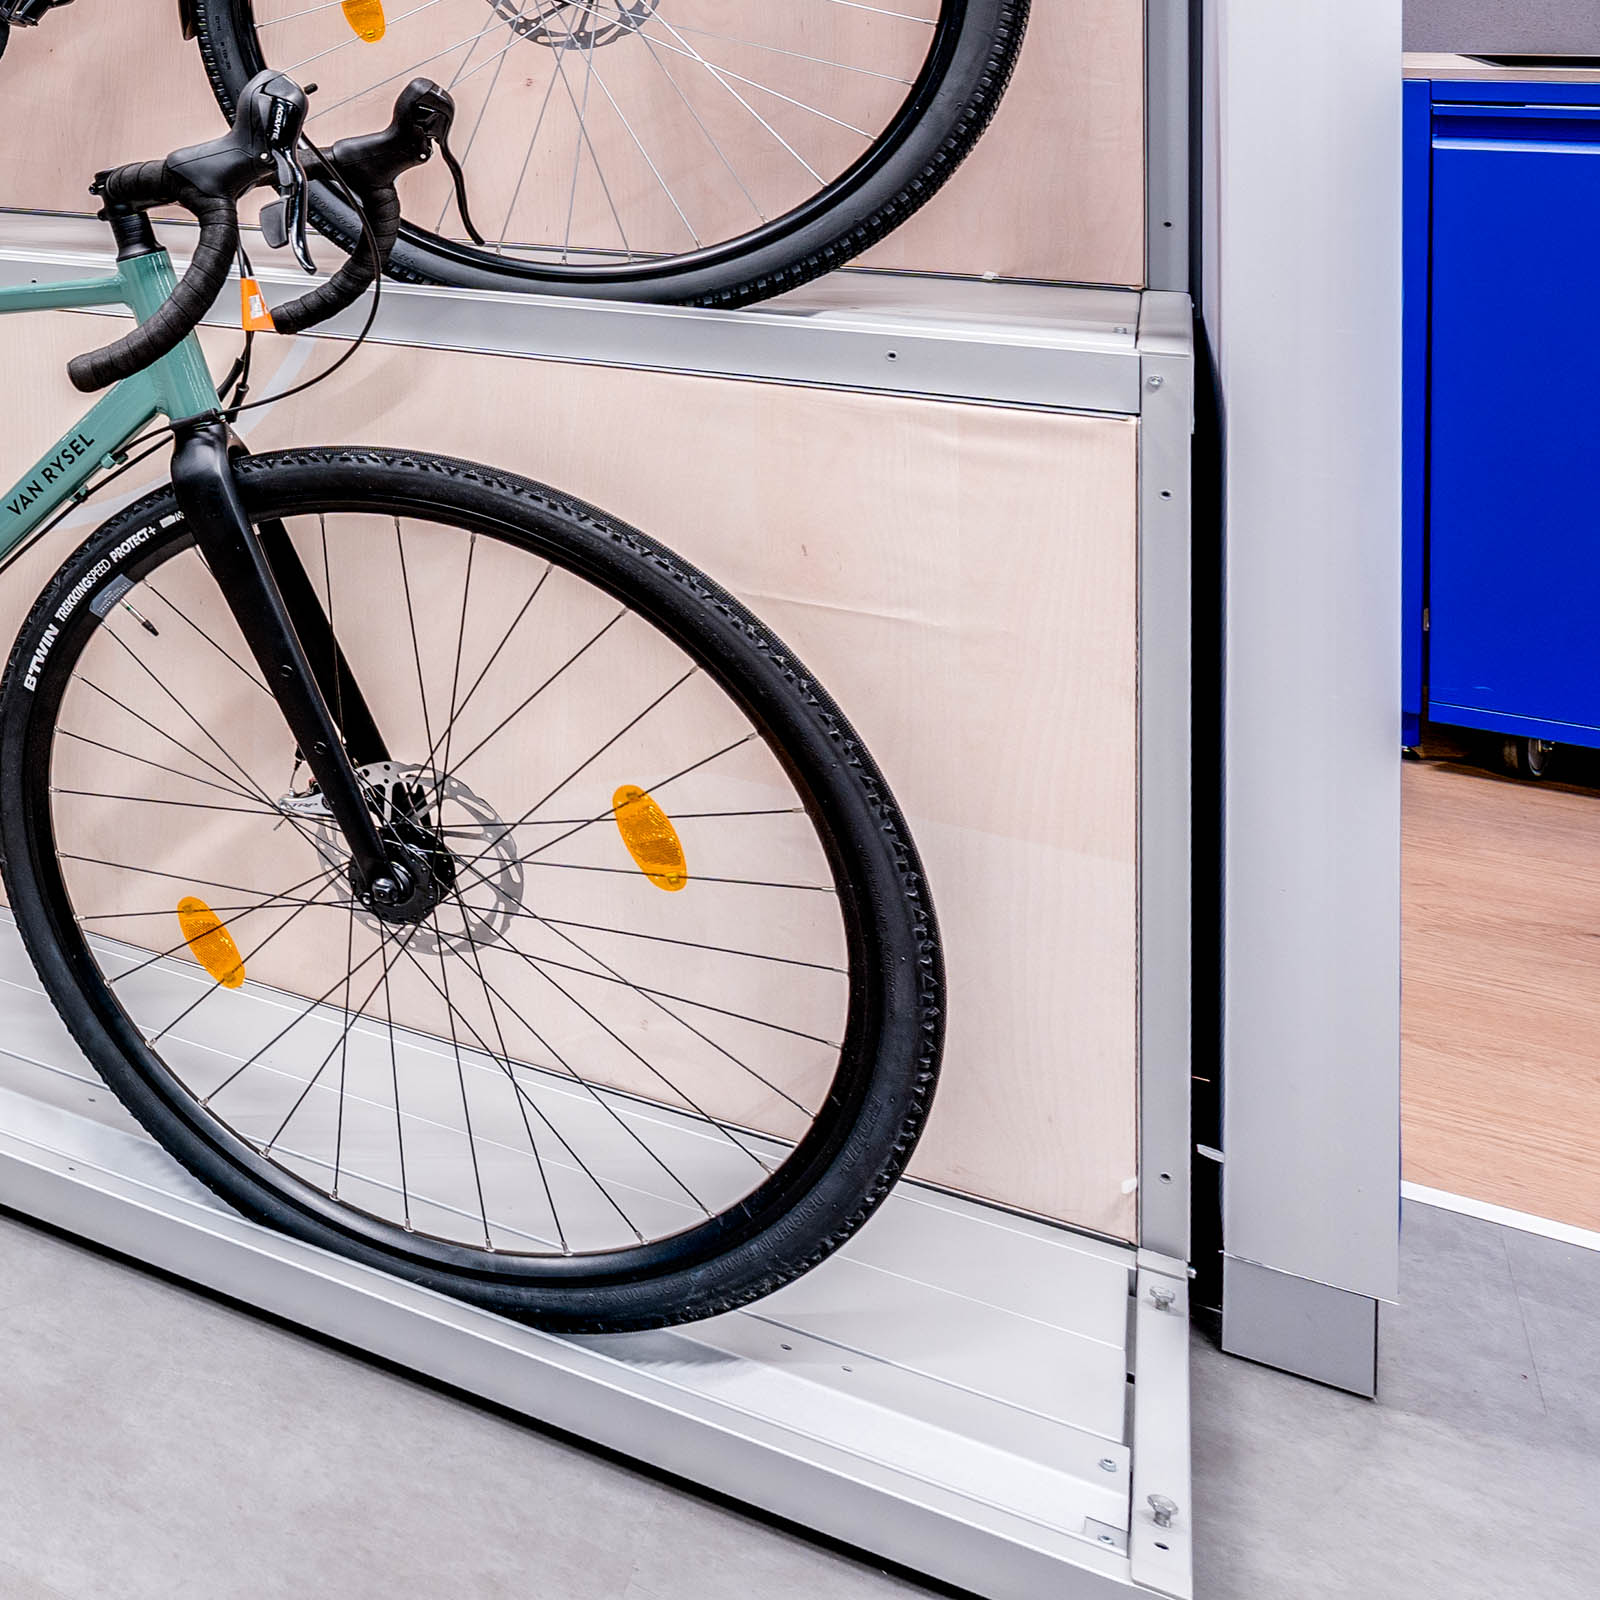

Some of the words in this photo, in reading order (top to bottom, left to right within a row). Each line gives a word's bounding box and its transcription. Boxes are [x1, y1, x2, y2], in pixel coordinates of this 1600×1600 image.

[270, 103, 284, 141] ACOLYTE
[7, 480, 44, 516] VAN
[45, 434, 96, 484] RYSEL
[54, 558, 111, 623] TREKKINGSPEED
[109, 526, 157, 564] PROTECT+
